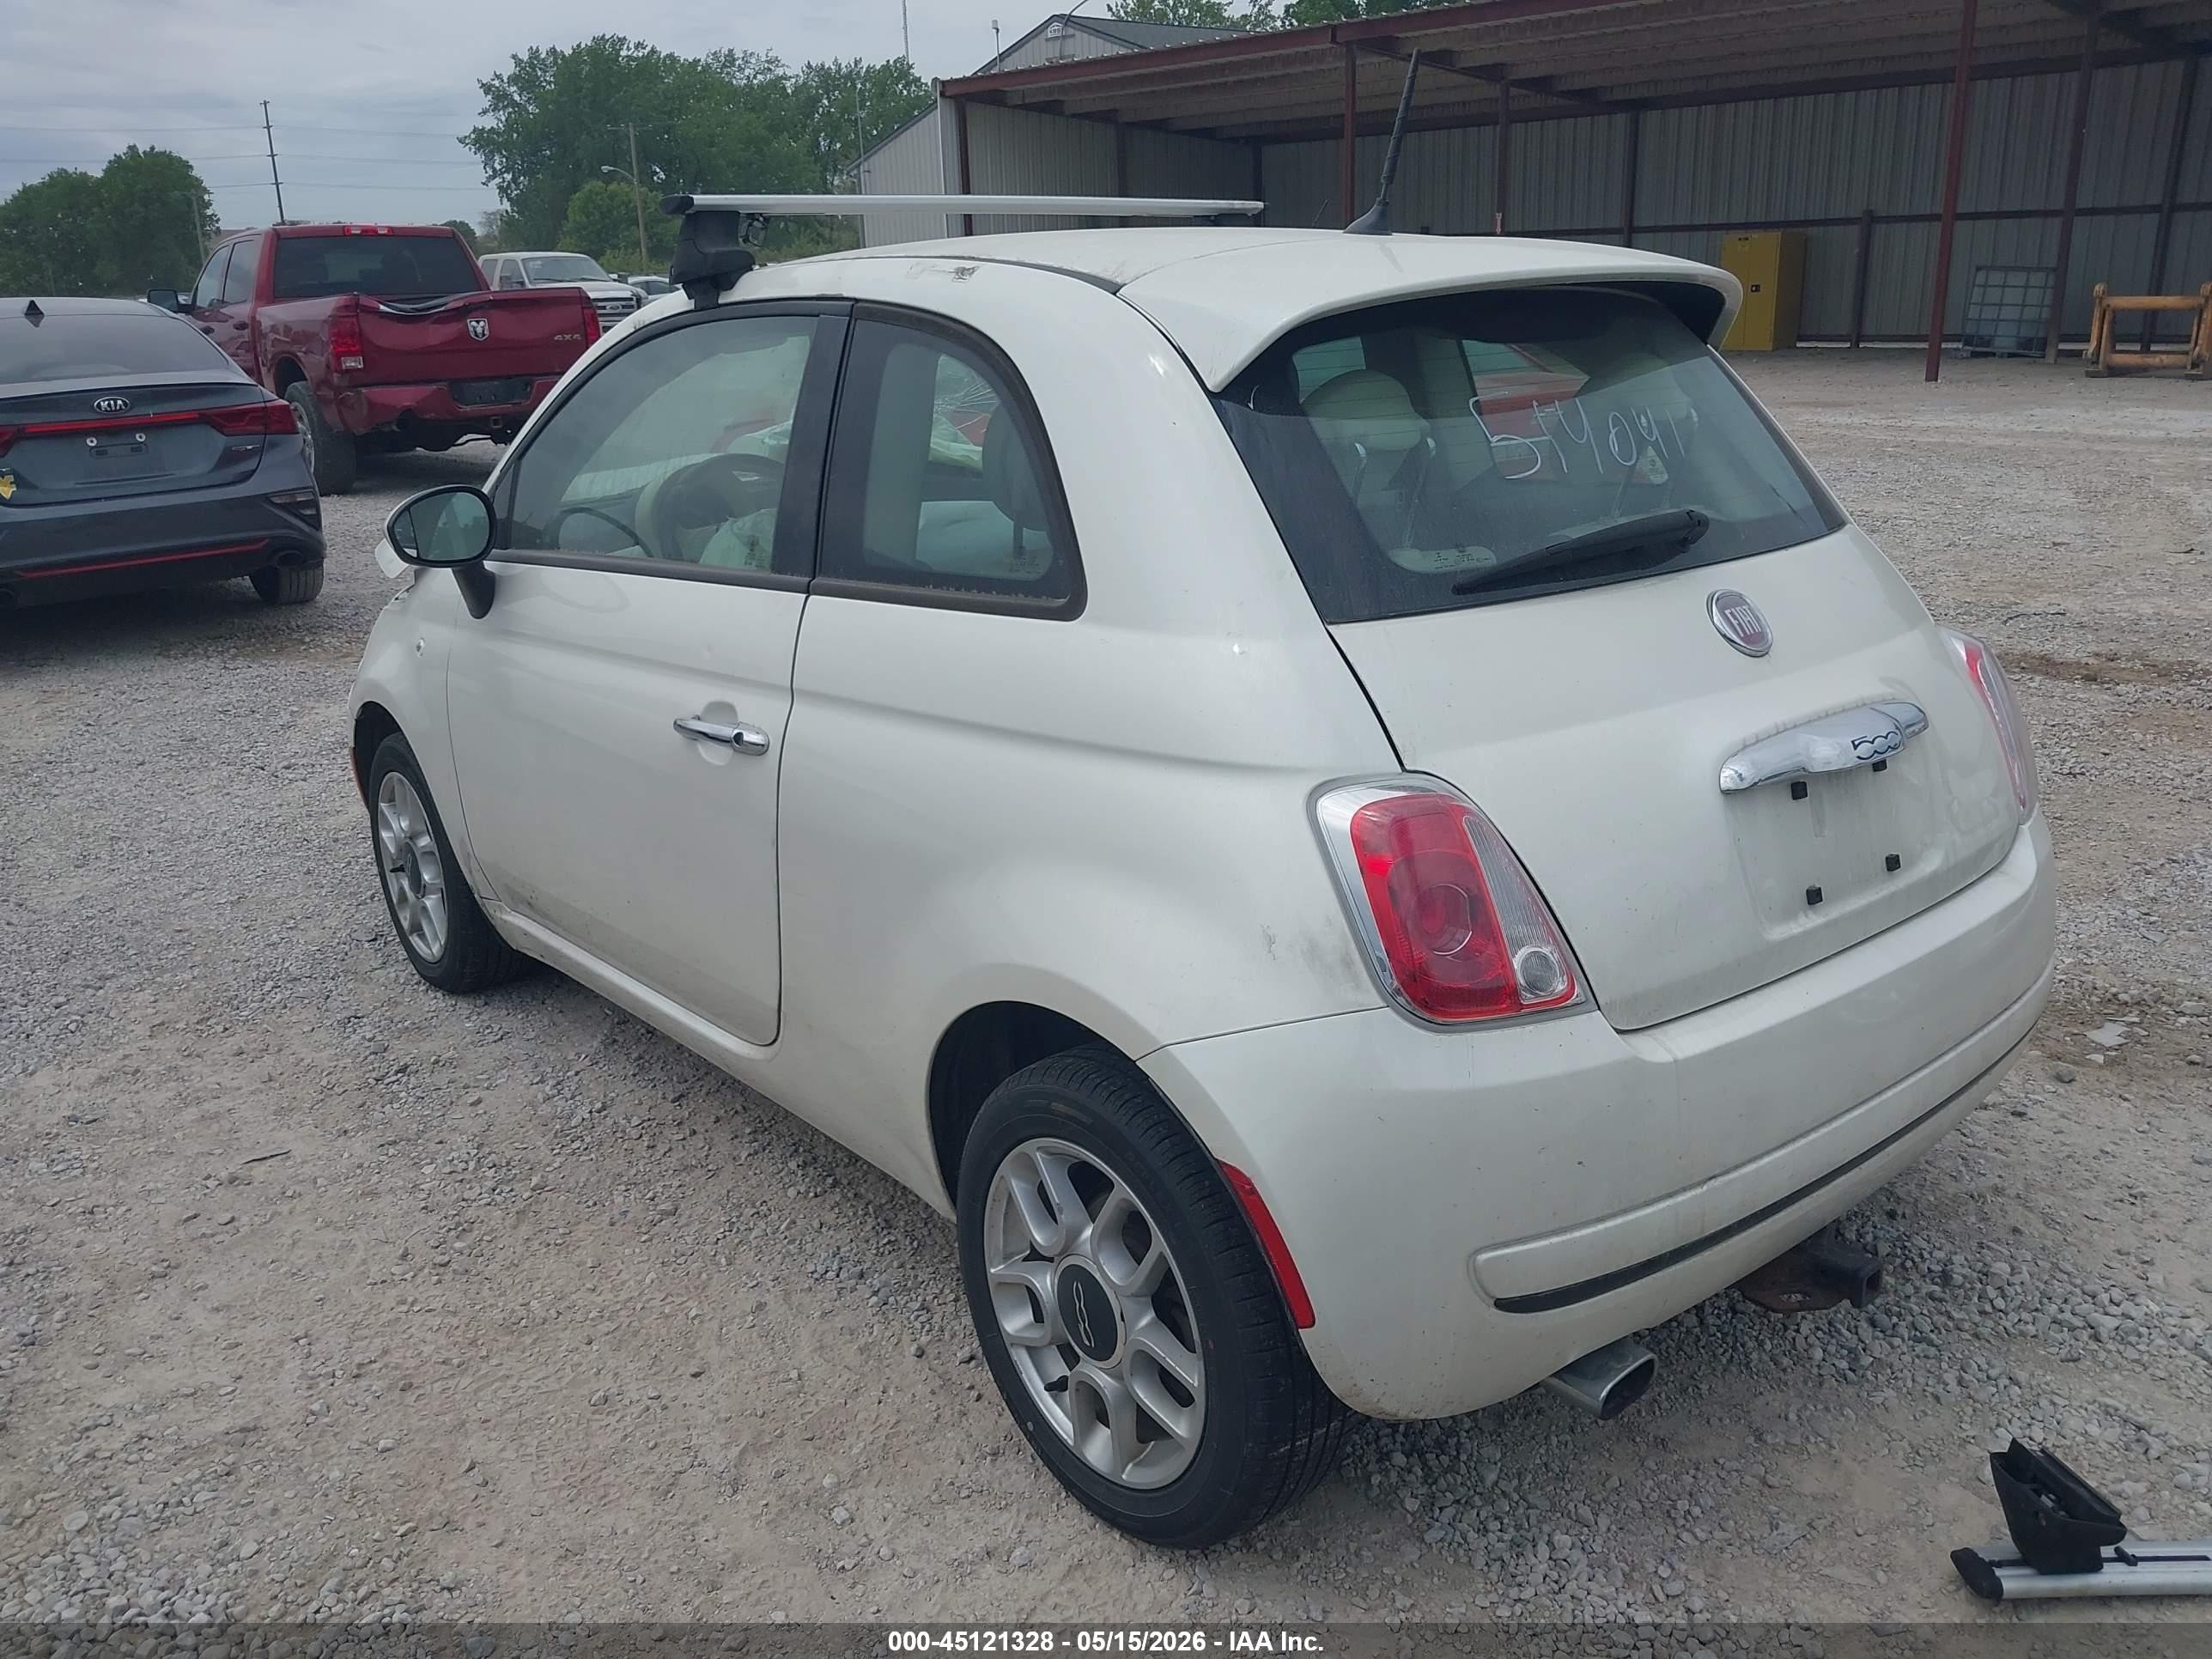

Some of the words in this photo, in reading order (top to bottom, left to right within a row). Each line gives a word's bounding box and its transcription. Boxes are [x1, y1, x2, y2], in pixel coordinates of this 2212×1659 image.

[100, 399, 125, 411] KIA
[1724, 605, 1762, 637] FIAT
[1850, 731, 1901, 760] 500
